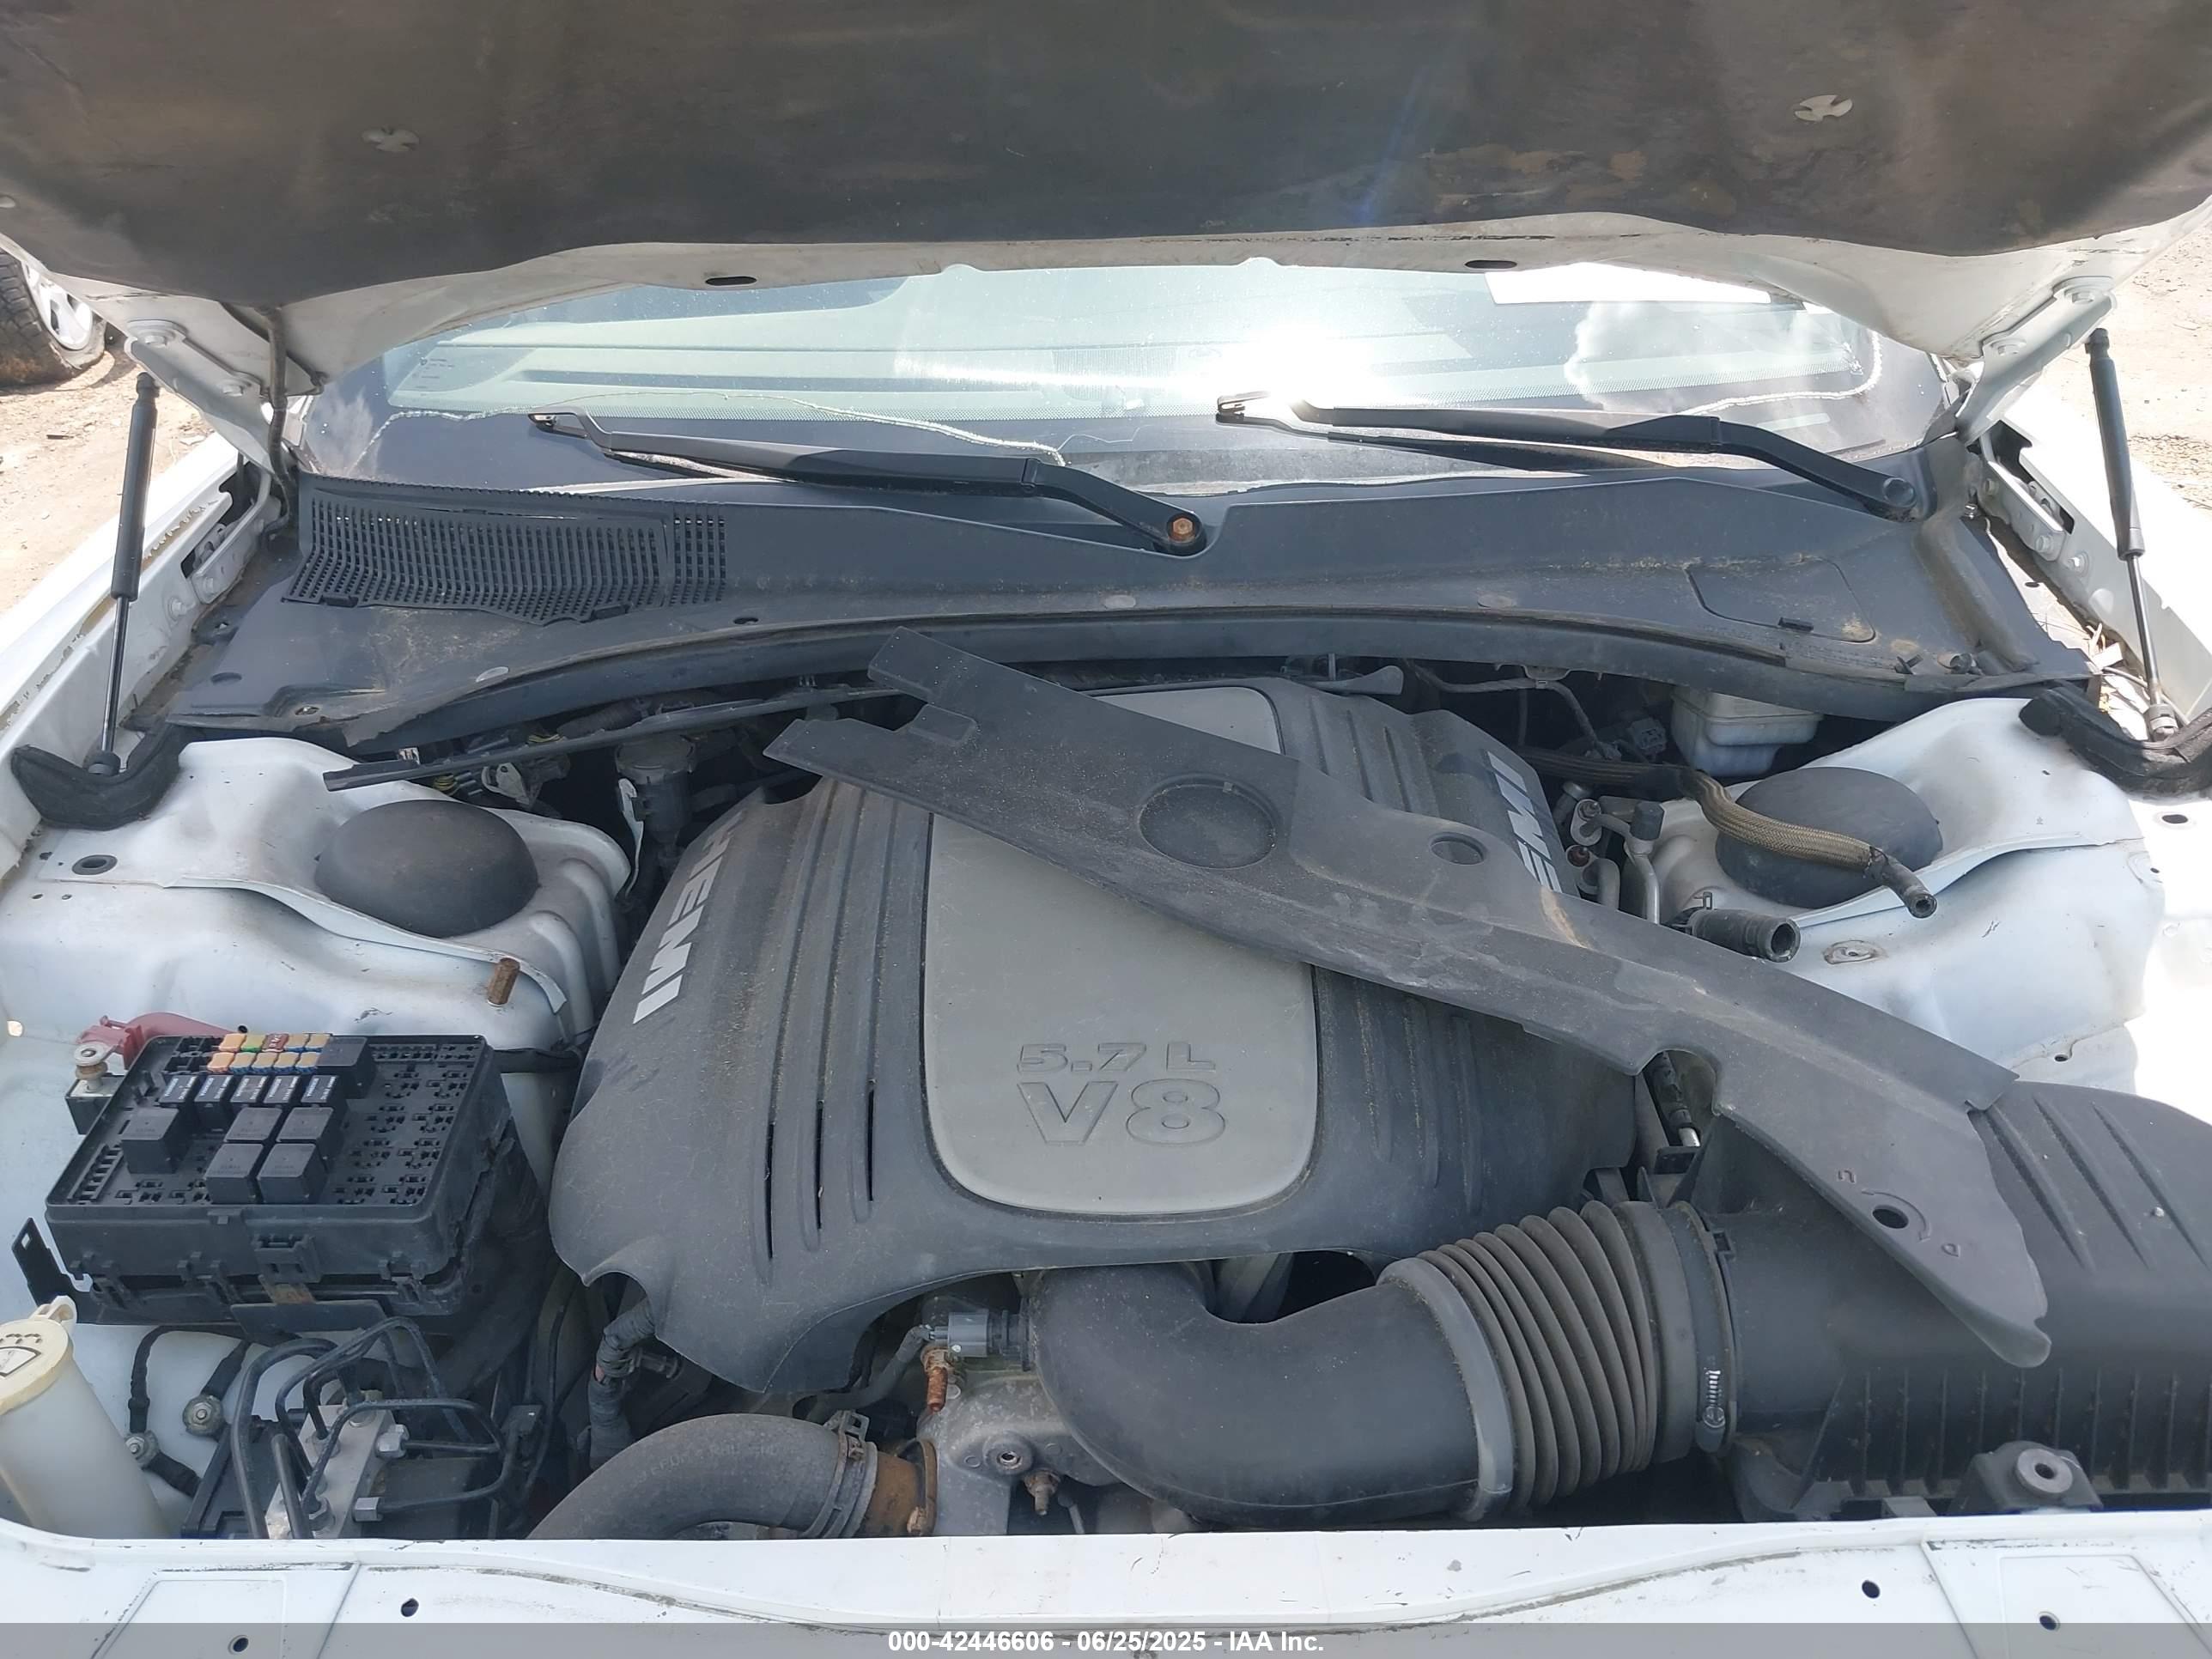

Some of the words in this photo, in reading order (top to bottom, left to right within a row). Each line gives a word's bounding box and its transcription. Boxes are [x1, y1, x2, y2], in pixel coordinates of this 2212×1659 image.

[1486, 750, 1563, 894] EMI
[632, 810, 744, 1024] HEMI
[1016, 1077, 1226, 1147] V8
